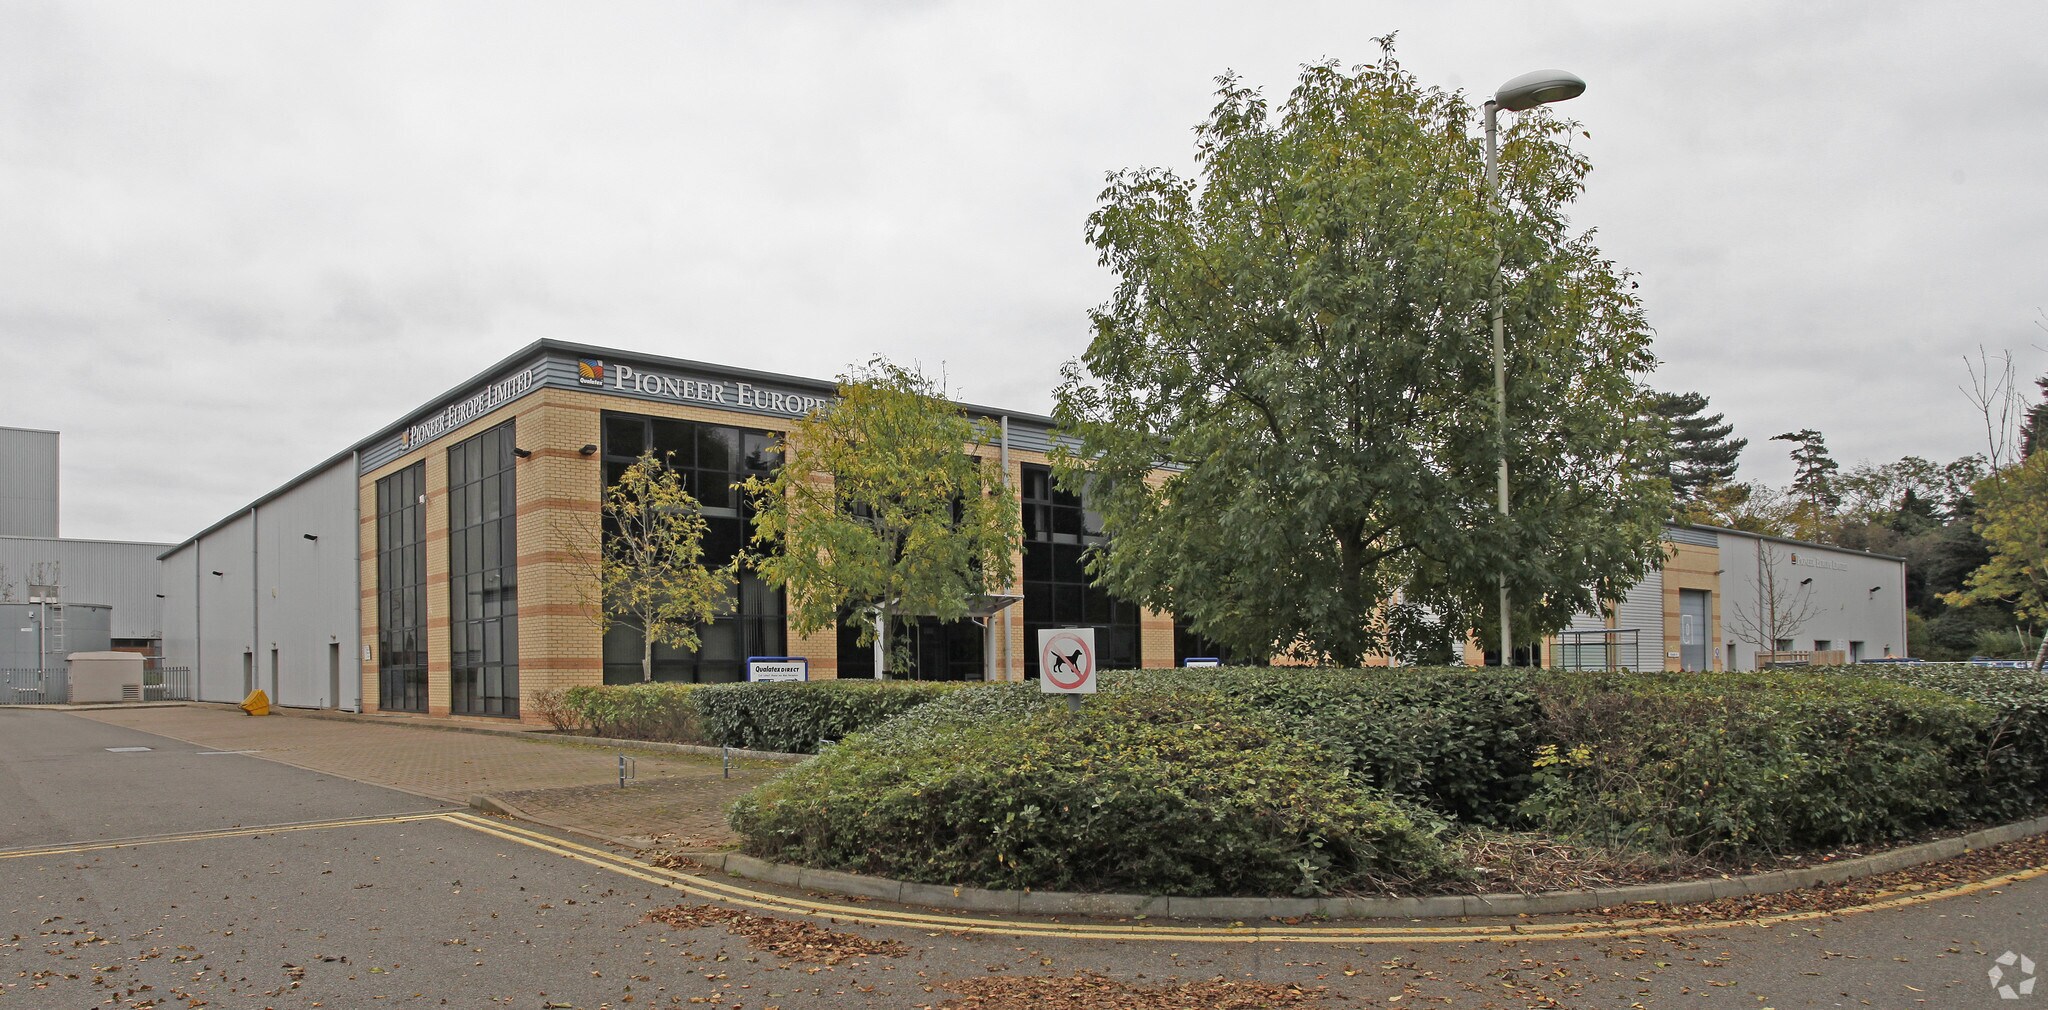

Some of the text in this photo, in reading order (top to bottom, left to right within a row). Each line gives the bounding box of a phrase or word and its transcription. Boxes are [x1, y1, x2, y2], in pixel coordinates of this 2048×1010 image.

[410, 369, 533, 447] PIONEER EUROPE LIMITED
[613, 364, 726, 404] PIONEER
